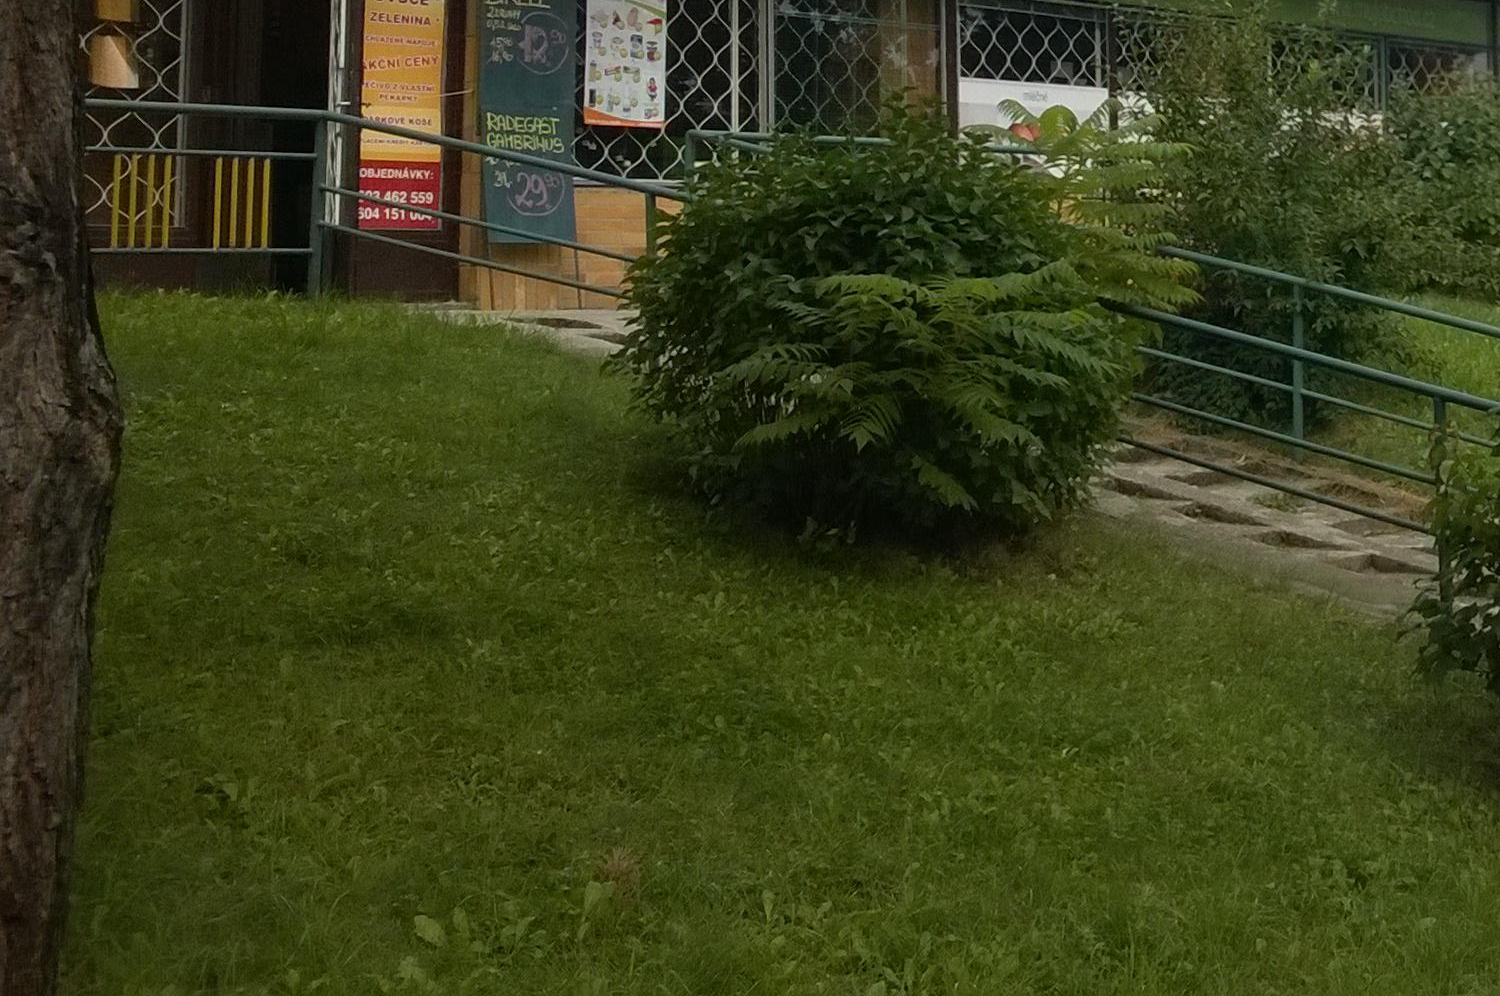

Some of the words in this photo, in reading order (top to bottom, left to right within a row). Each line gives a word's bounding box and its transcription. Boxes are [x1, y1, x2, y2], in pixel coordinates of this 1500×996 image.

[369, 11, 432, 26] ZELENINA
[404, 55, 439, 68] CENY
[486, 111, 560, 135] RADEGAST
[359, 166, 435, 180] OBJEDNÁVKY:
[383, 190, 408, 204] 462
[410, 191, 434, 205] 559
[384, 207, 406, 221] 151
